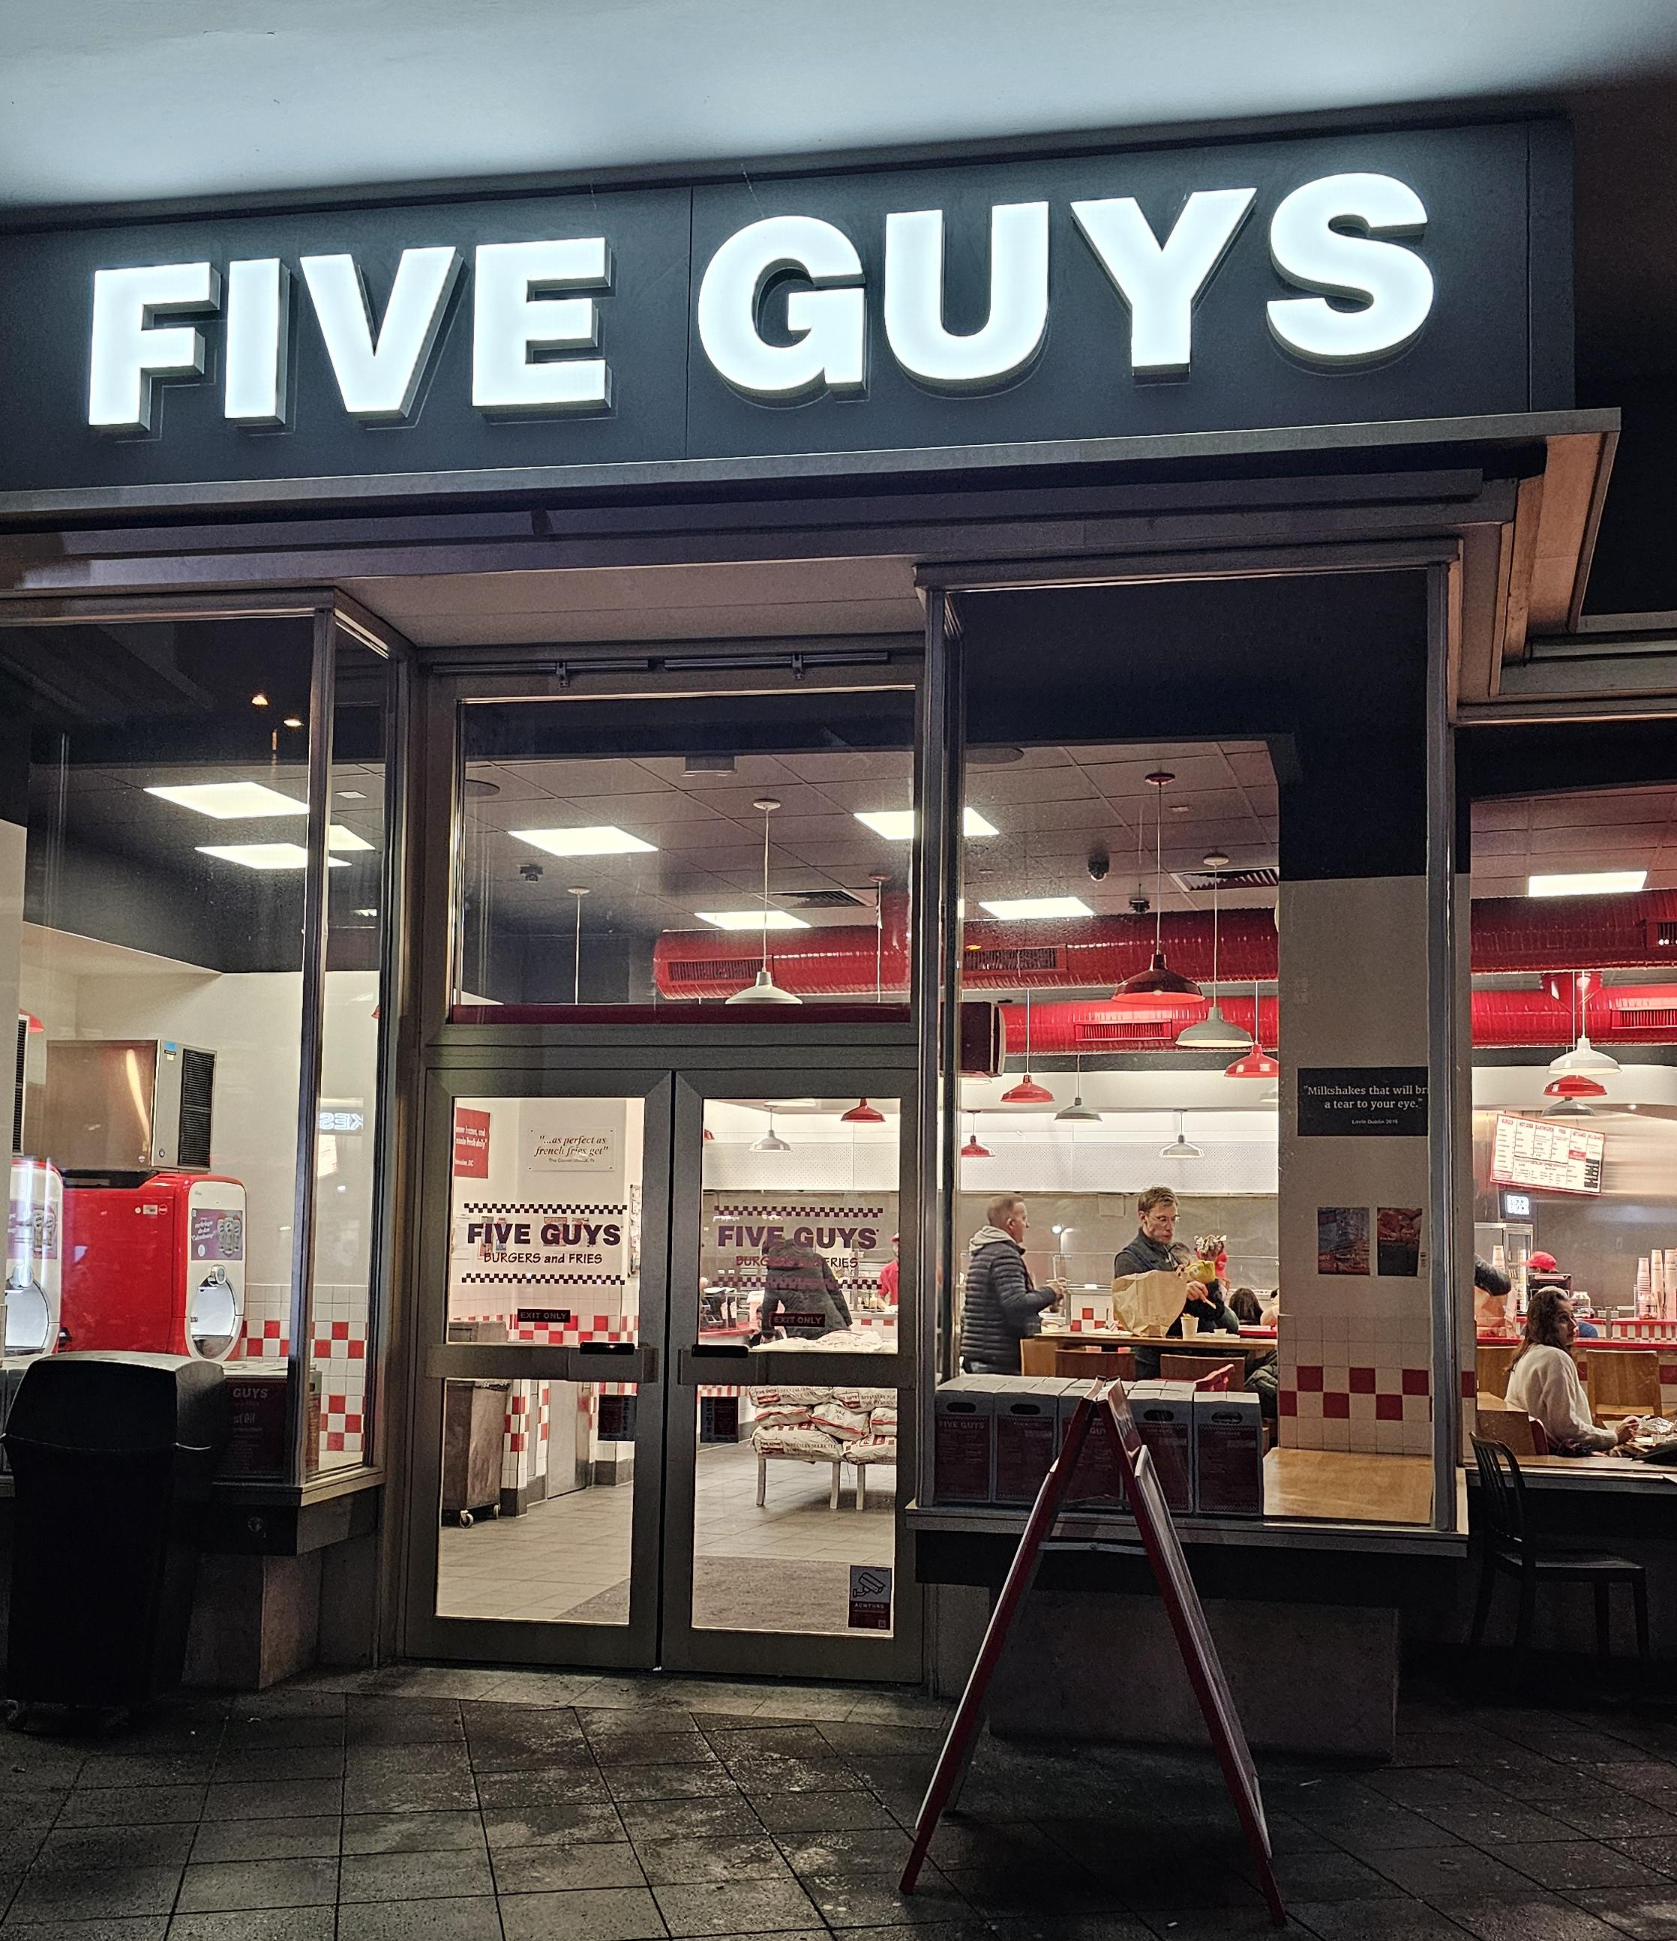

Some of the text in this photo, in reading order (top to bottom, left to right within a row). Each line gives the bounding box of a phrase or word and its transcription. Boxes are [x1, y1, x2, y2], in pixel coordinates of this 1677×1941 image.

[89, 172, 1434, 430] FIVE GUYS
[1369, 1085, 1390, 1095] that
[1392, 1085, 1413, 1095] will
[1324, 1101, 1331, 1109] a
[1333, 1100, 1354, 1109] tear
[1357, 1100, 1368, 1109] to
[1370, 1100, 1395, 1110] your
[563, 1135, 595, 1146] perfect
[533, 1146, 565, 1157] french
[467, 1223, 621, 1246] FIVE GUYS
[717, 1225, 877, 1250] FIVE GUYS
[484, 1253, 603, 1264] BURGERS and FRIES
[520, 1311, 567, 1320] EXIT ONLY
[773, 1316, 822, 1324] EXIT ONLY
[233, 1388, 269, 1398] GUYS
